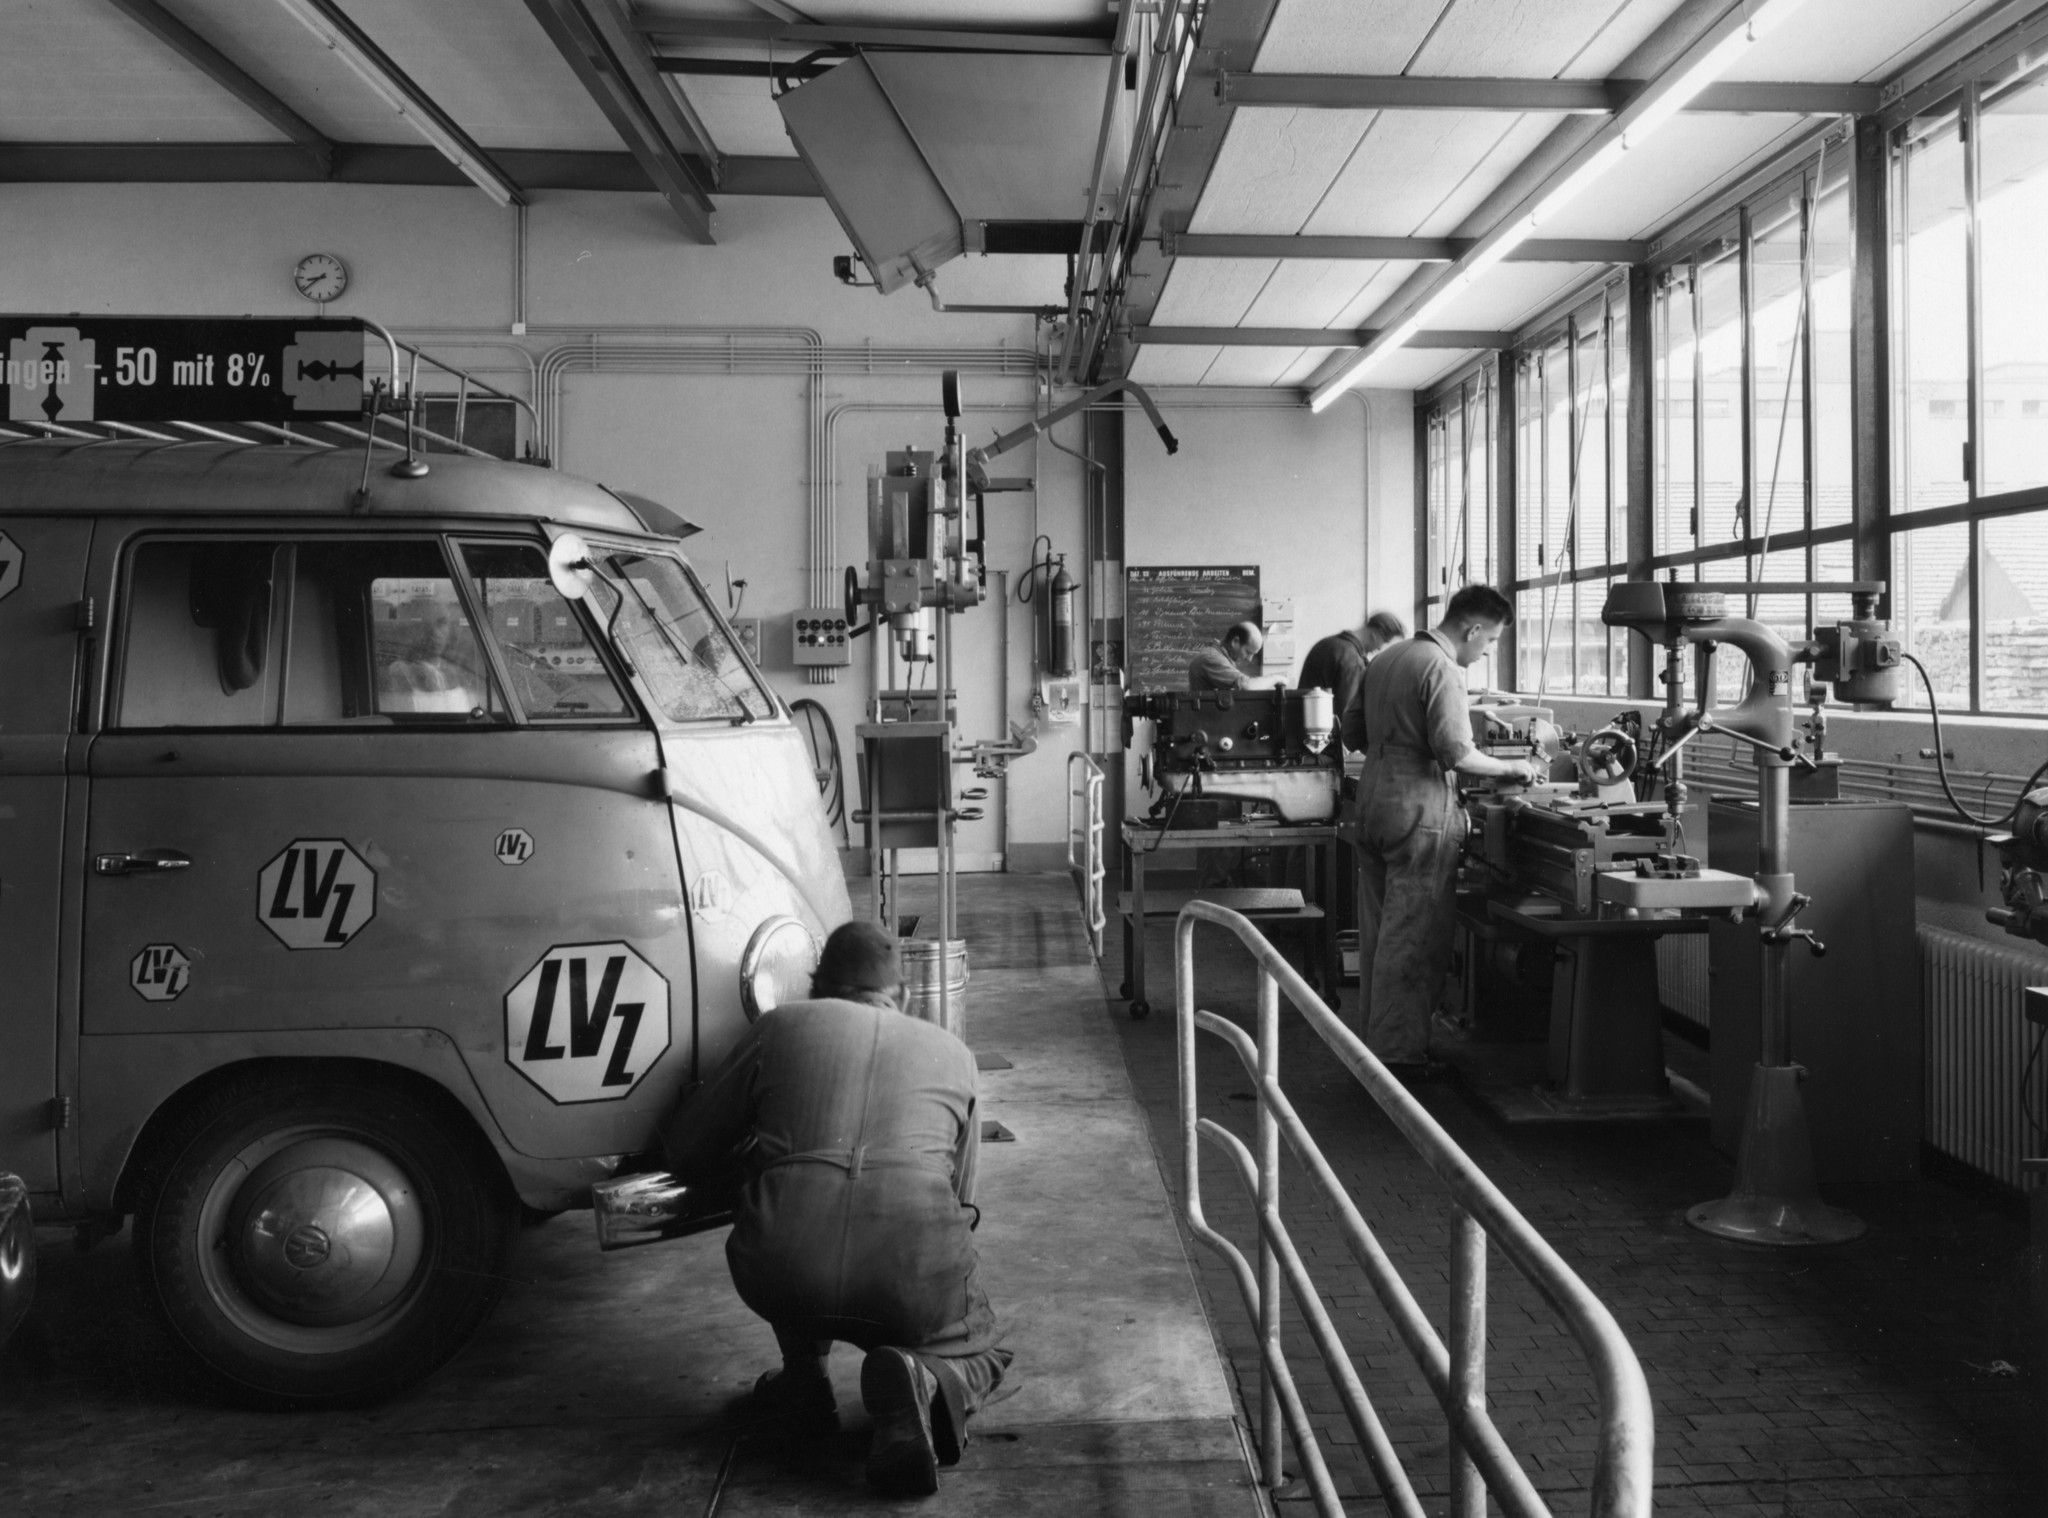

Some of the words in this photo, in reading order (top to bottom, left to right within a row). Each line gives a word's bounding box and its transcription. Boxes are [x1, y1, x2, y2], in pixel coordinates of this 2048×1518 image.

[173, 353, 214, 386] mit
[227, 352, 270, 387] 8%
[496, 834, 528, 860] LVZ
[269, 849, 354, 943] LVZ
[523, 956, 645, 1087] LVZ
